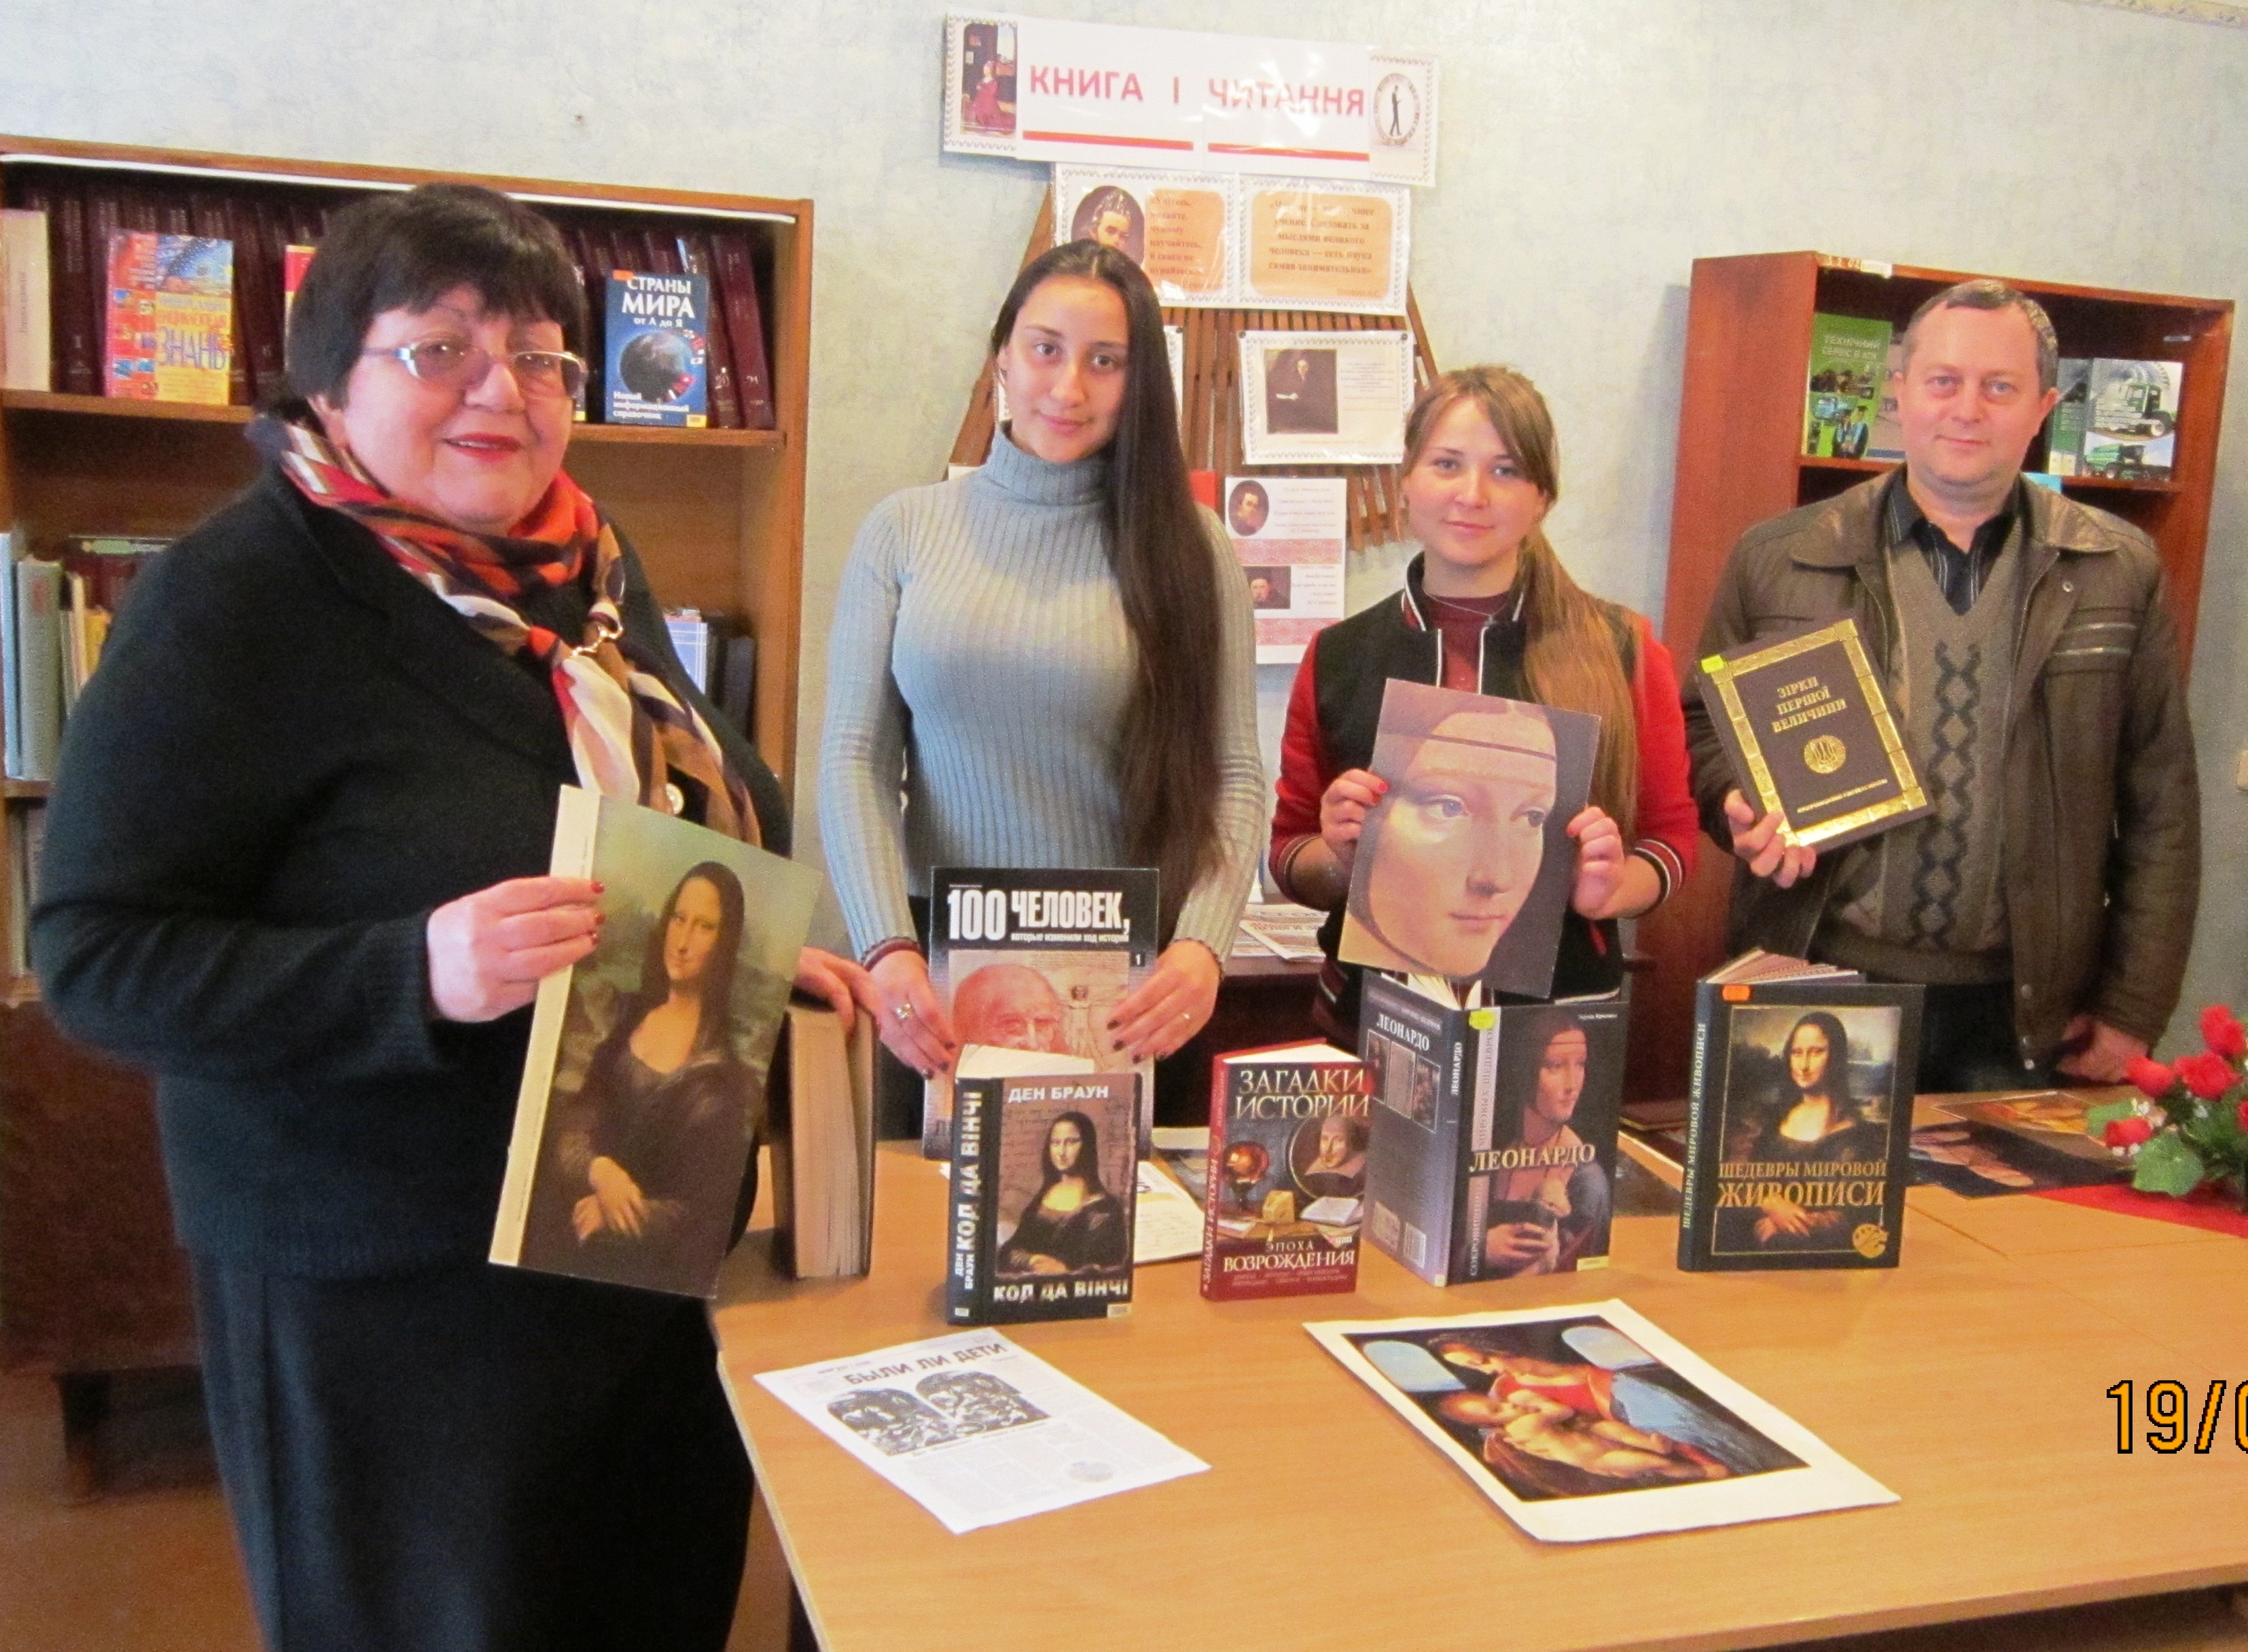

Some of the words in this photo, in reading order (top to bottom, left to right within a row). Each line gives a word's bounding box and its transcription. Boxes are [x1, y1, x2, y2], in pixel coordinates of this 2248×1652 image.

[1030, 65, 1143, 101] КНИГА
[1209, 78, 1364, 116] ЧИТАННЯ
[1278, 234, 1321, 243] мыслями
[1323, 236, 1365, 245] великого
[1268, 247, 1310, 256] человека
[1346, 253, 1373, 261] наука
[1268, 262, 1296, 270] самая
[627, 276, 691, 294] СТРАНЫ
[622, 293, 695, 318] МИРА
[648, 317, 656, 325] А
[675, 319, 683, 327] Я
[1776, 685, 1831, 715] ПЕРШОЇ
[1777, 676, 1819, 699] ЗІРКИ
[1771, 698, 1847, 733] ВЕЛИЧИНИ
[947, 889, 1006, 941] 100
[1011, 891, 1130, 935] ЧЕЛОВЕК,
[1011, 933, 1043, 942] которые
[1044, 933, 1082, 941] изменили
[1083, 934, 1097, 943] ход
[1099, 934, 1130, 943] истории
[1135, 954, 1141, 965] 1
[1376, 1011, 1430, 1051] ЛЕОНАРДО
[1451, 1042, 1462, 1096] ЛЕОНАРДО
[1692, 1022, 1706, 1098] ЖИВОПИСИ
[1008, 1088, 1045, 1103] ДЕН
[1050, 1085, 1109, 1100] БРАУН
[1239, 1069, 1364, 1096] ЗАГАДКИ
[1235, 1094, 1370, 1119] ИСТОРИИ
[961, 1092, 982, 1156] ВІНЧІ
[1688, 1102, 1700, 1164] МИРОВОЙ
[1469, 1144, 1596, 1173] ЛЕОНАРДО
[1719, 1162, 1799, 1180] ШЕДЕВРЫ
[1804, 1159, 1887, 1177] МИРОВОЙ
[960, 1163, 982, 1197] ДА
[1717, 1179, 1886, 1208] ЖИВОПИСИ
[1682, 1168, 1695, 1229] ШЕДЕВРЫ
[957, 1204, 980, 1251] КОД
[1266, 1241, 1315, 1253] ЭПОХА
[955, 1253, 965, 1278] ДЕН
[965, 1253, 976, 1290] БРАУН
[1223, 1251, 1355, 1273] ВОЗРОЖДЕНИЯ
[993, 1285, 1035, 1304] КОД
[1041, 1282, 1068, 1301] ДА
[1073, 1279, 1128, 1298] ВІНЧІ
[843, 1363, 914, 1385] БЫЛИ
[916, 1354, 951, 1369] ЛИ
[953, 1343, 1007, 1363] ДЕТИ
